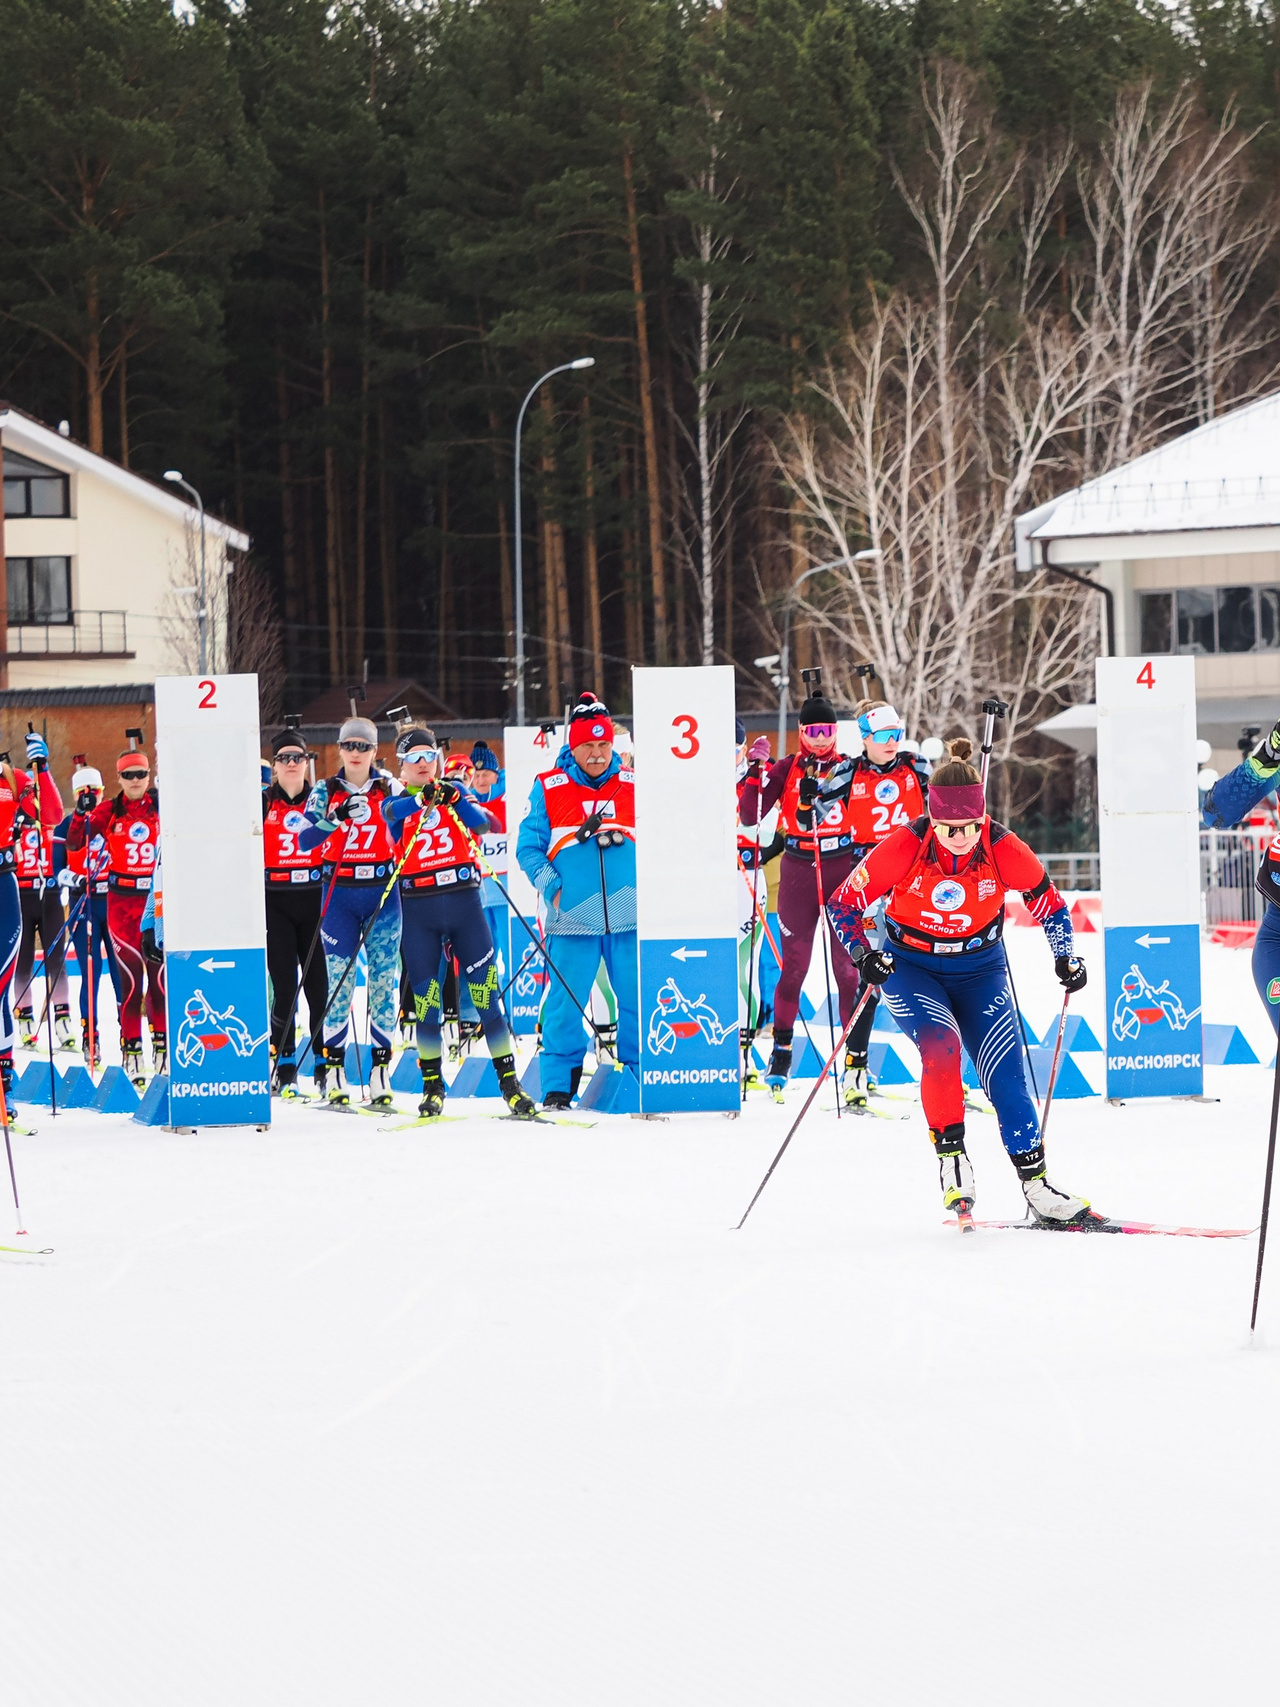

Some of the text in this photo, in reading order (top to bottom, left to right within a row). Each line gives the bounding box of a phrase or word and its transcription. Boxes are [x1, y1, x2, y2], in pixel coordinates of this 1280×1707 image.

[1136, 661, 1156, 689] 4
[198, 680, 217, 709] 2
[671, 714, 700, 760] 3
[548, 775, 564, 786] 35
[824, 800, 843, 826] 8
[871, 803, 909, 833] 24
[345, 825, 378, 851] 27
[416, 827, 454, 860] 23
[125, 843, 155, 866] 39
[513, 1006, 539, 1017] КРАС
[1108, 1054, 1201, 1072] КРАСНОЯРСК
[643, 1069, 738, 1085] КРАСНОЯРСК
[171, 1081, 269, 1098] КРАСНОЯРСК
[1025, 1152, 1039, 1161] 172
